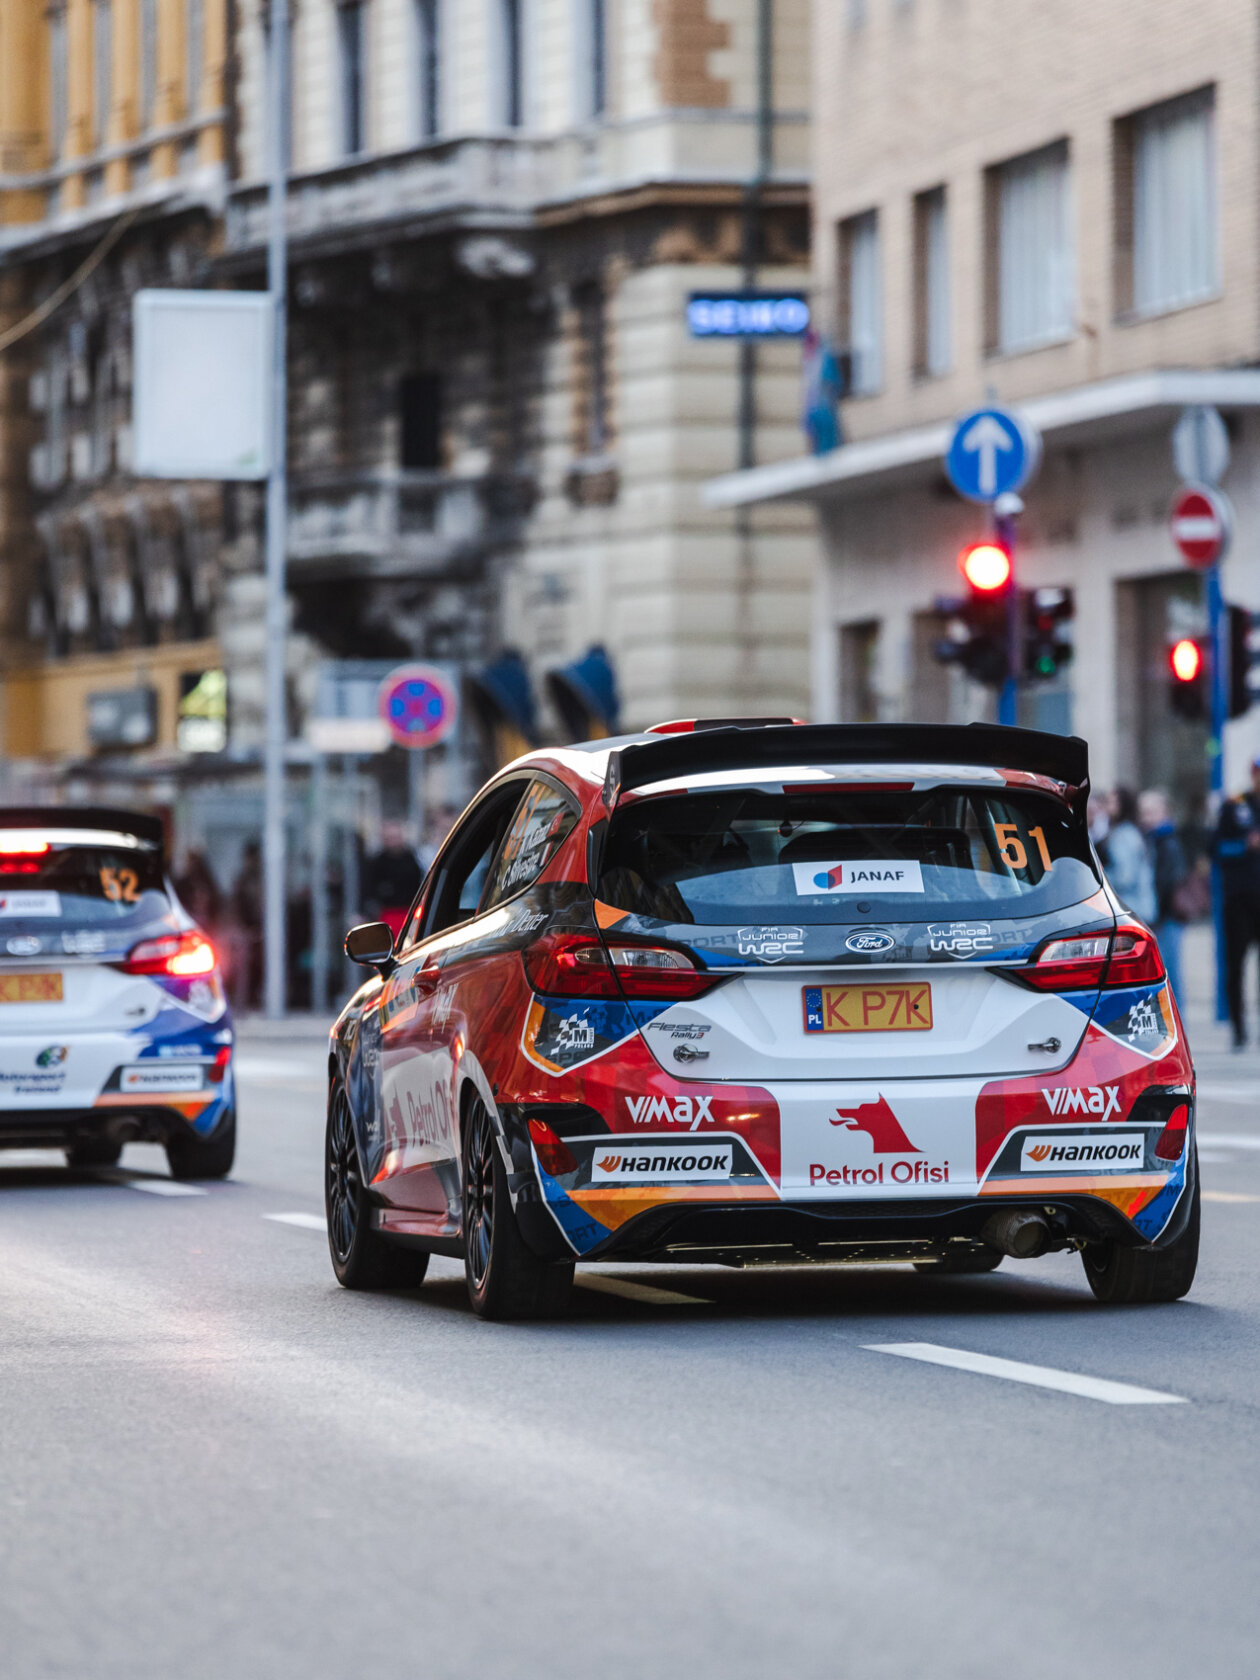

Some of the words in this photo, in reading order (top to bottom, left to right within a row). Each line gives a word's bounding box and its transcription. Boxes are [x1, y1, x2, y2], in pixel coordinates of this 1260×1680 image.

[687, 298, 809, 334] SEIKO
[993, 822, 1053, 872] 51
[100, 867, 141, 902] 52
[850, 870, 905, 884] JANAF
[738, 941, 804, 955] WRC
[856, 936, 883, 949] Ford
[930, 937, 994, 951] WRC
[827, 991, 850, 1027] K
[862, 989, 929, 1026] P7K
[647, 1022, 712, 1032] Fiesta
[808, 1015, 822, 1025] PL
[574, 1029, 588, 1043] M
[1050, 1144, 1142, 1161] HANKOOK
[620, 1155, 729, 1172] HANKOOK
[809, 1162, 884, 1186] Petrol
[891, 1160, 949, 1184] Ofisi
